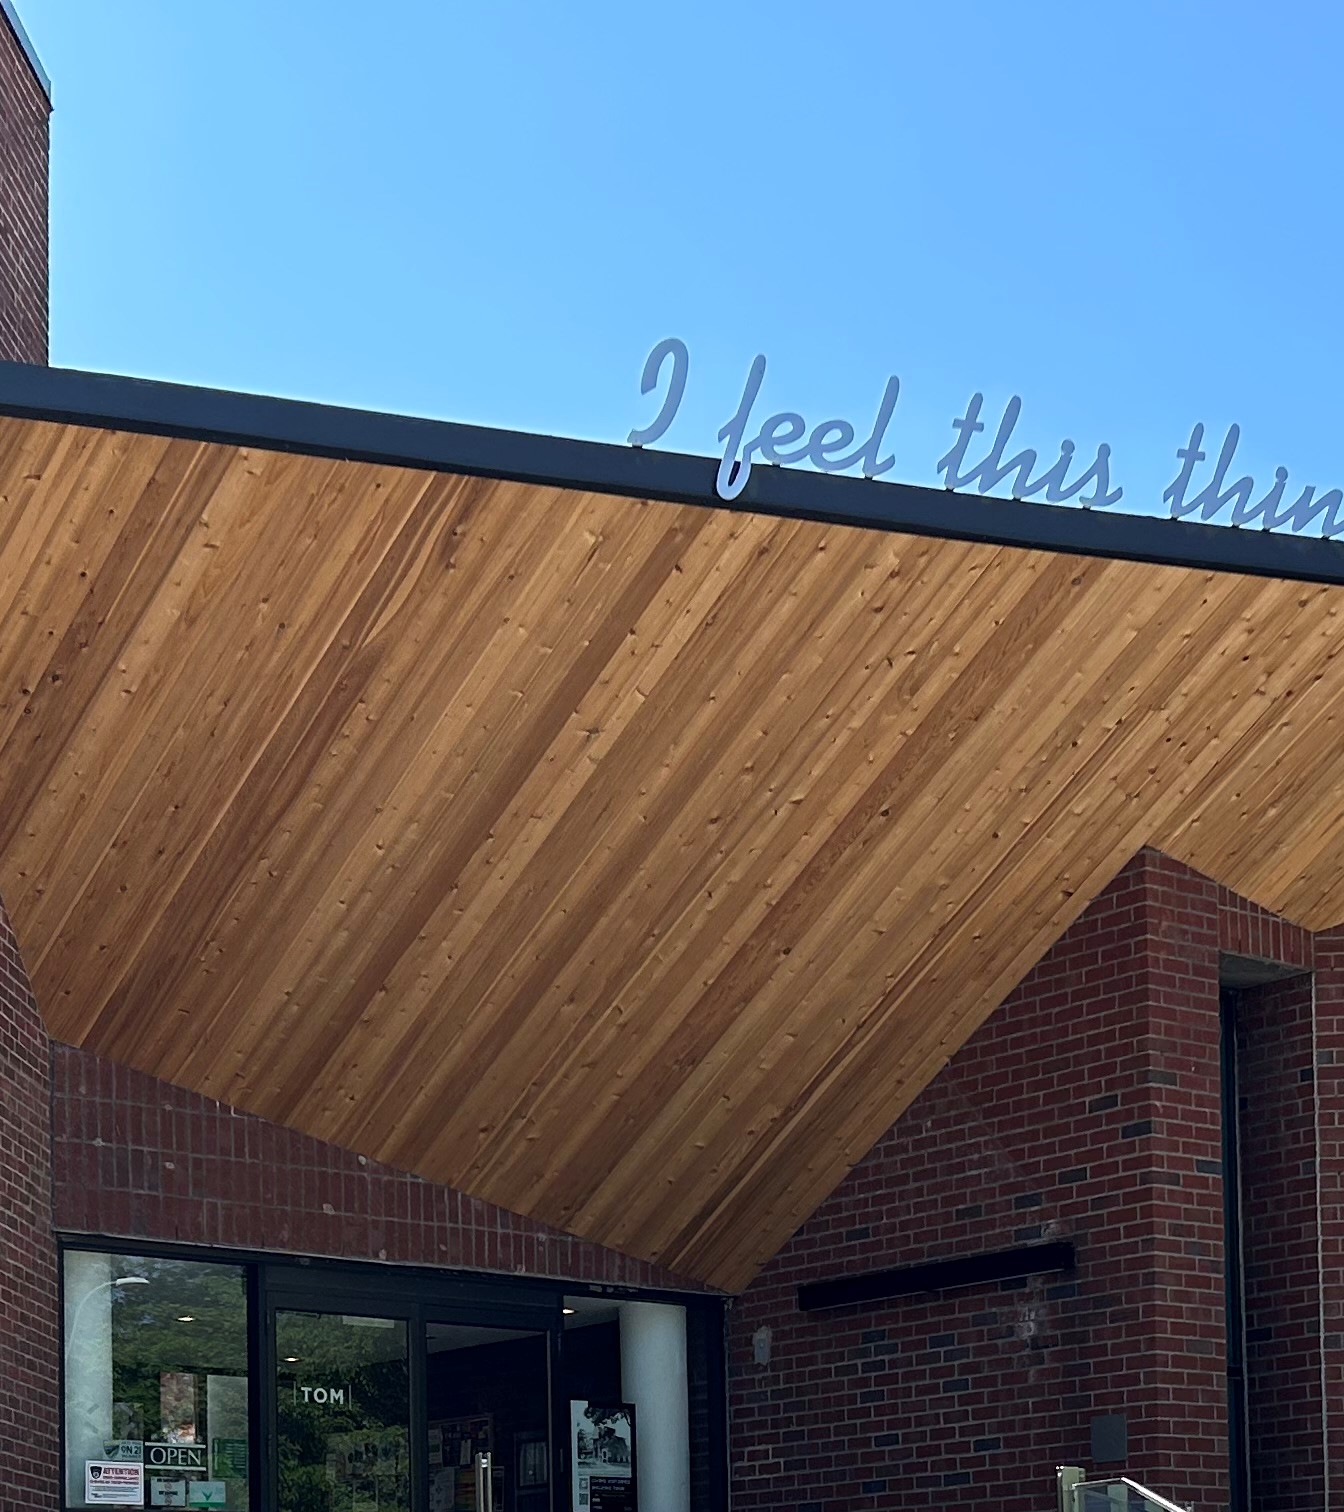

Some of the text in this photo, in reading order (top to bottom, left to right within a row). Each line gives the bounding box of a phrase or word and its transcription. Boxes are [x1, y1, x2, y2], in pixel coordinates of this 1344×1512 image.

[628, 337, 689, 445] I
[716, 354, 900, 500] feel
[937, 392, 1123, 508] this
[300, 1386, 344, 1404] TOM
[150, 1447, 201, 1466] OPEN
